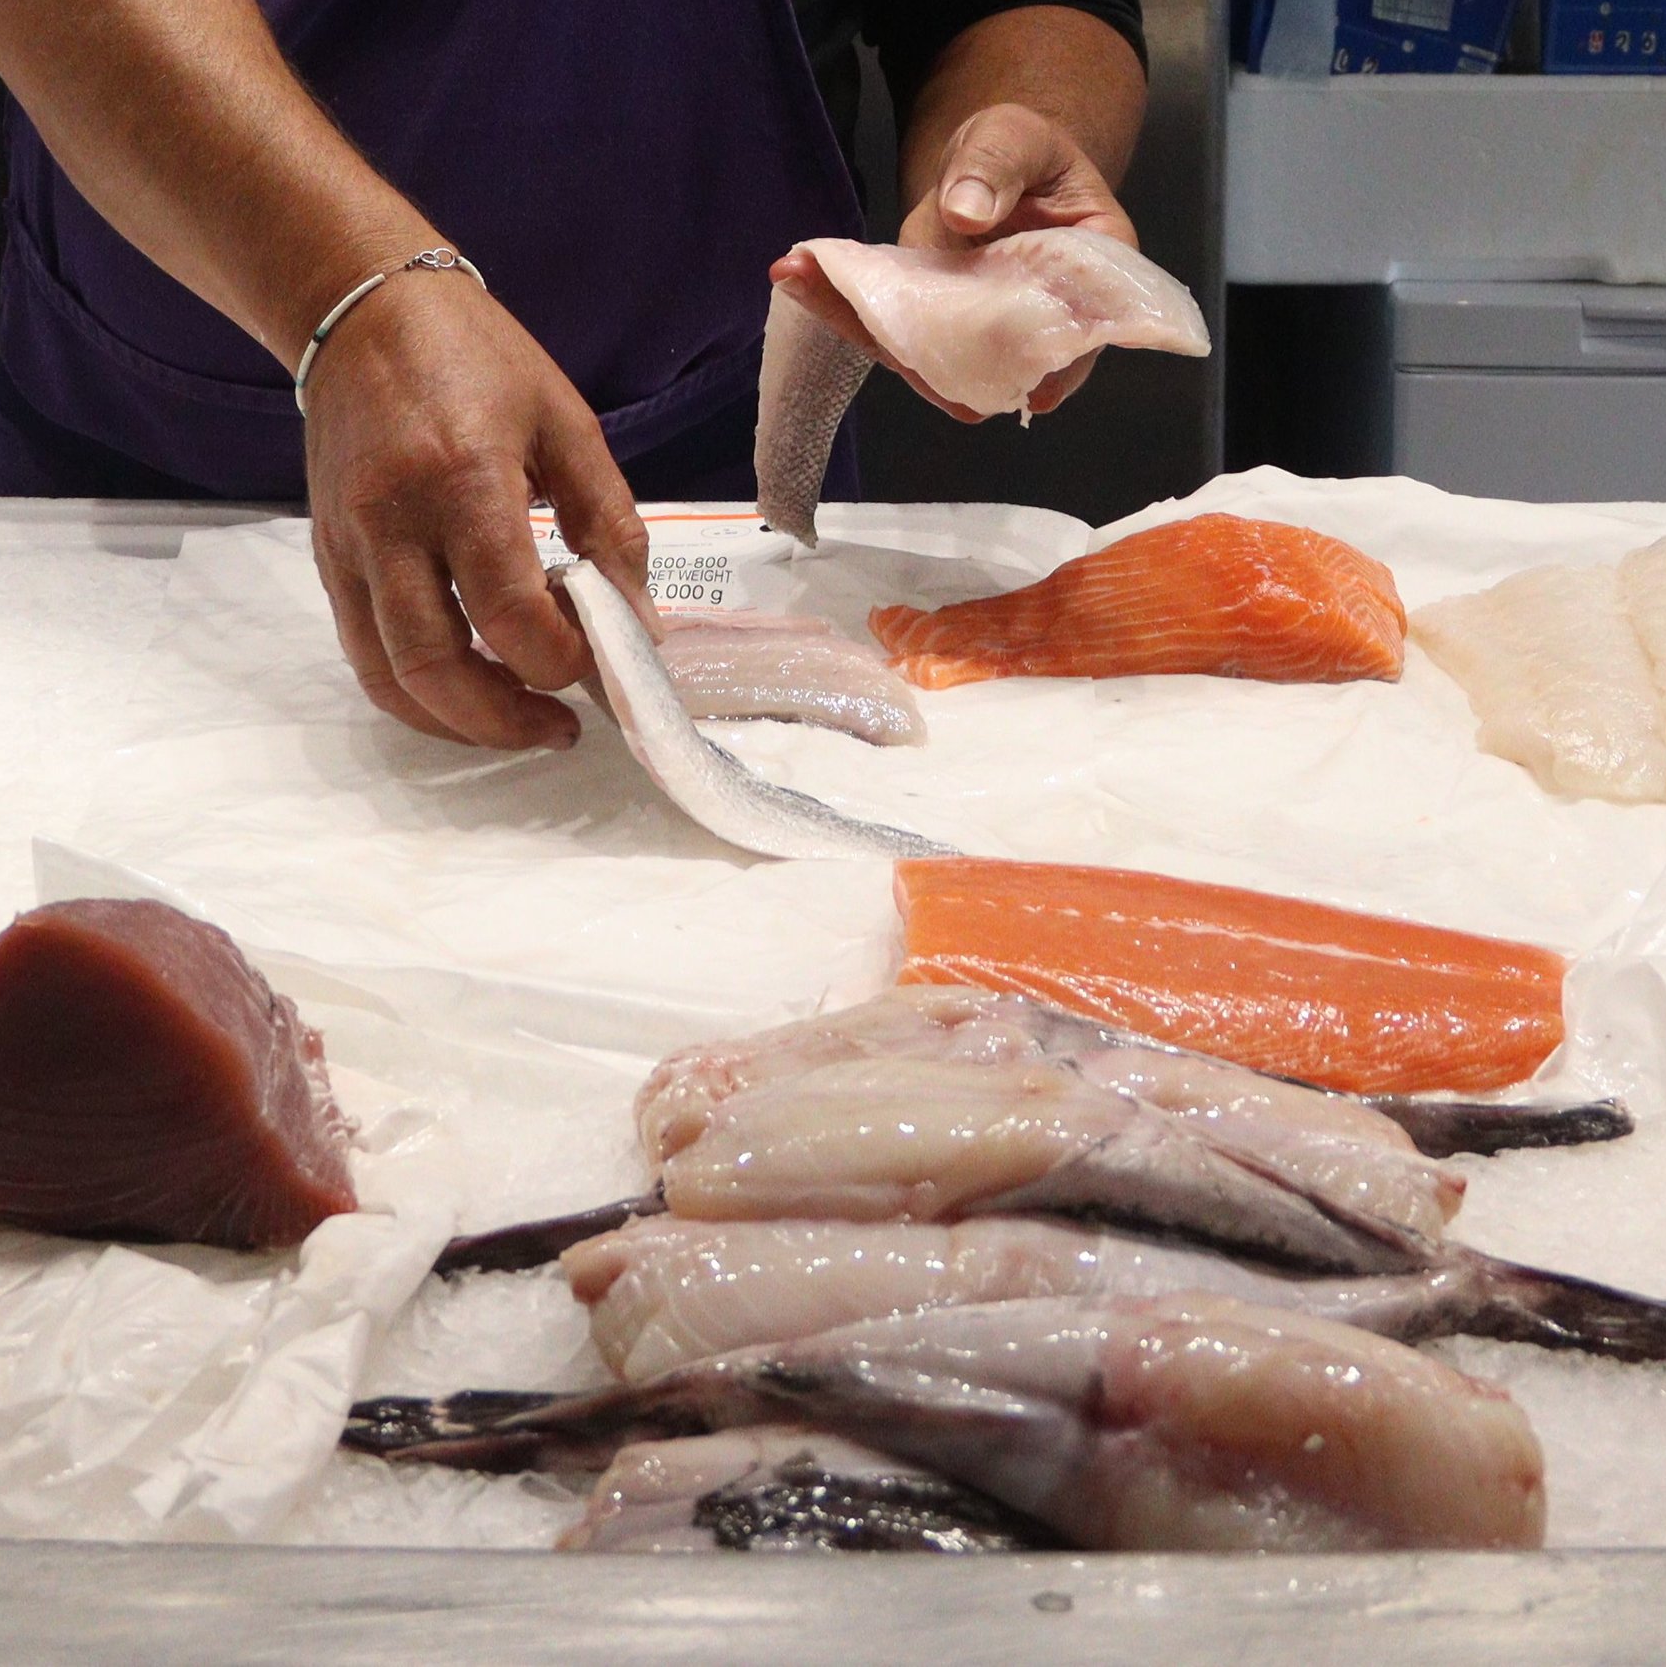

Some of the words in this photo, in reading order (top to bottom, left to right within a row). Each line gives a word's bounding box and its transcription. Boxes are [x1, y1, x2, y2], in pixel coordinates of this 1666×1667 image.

[652, 556, 728, 569] 600-800
[648, 570, 674, 581] NET
[678, 570, 733, 584] WEIGHT
[710, 589, 723, 605] g
